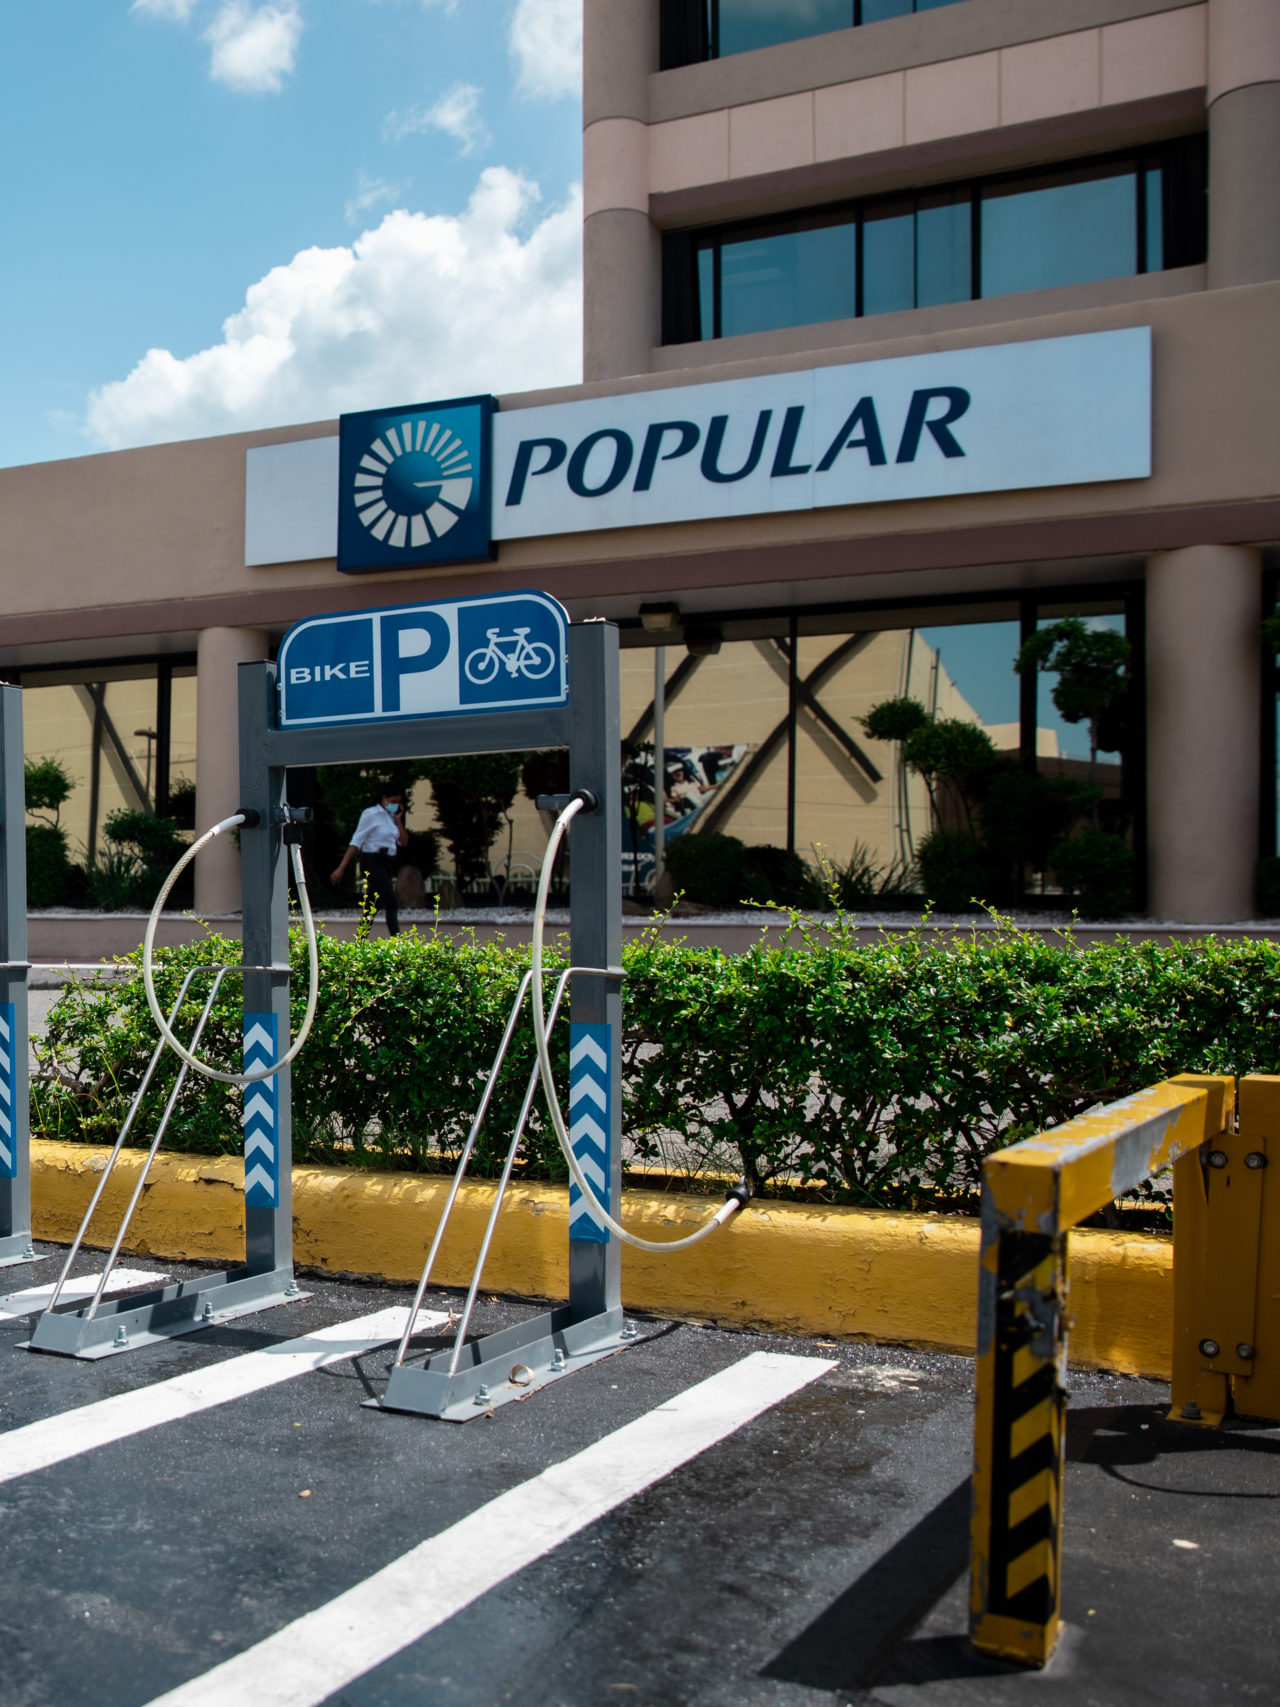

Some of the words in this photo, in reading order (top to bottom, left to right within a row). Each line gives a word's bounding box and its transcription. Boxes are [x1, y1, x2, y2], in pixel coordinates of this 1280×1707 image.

[505, 386, 971, 507] POPULAR
[290, 660, 370, 684] BIKE
[380, 611, 451, 712] P
